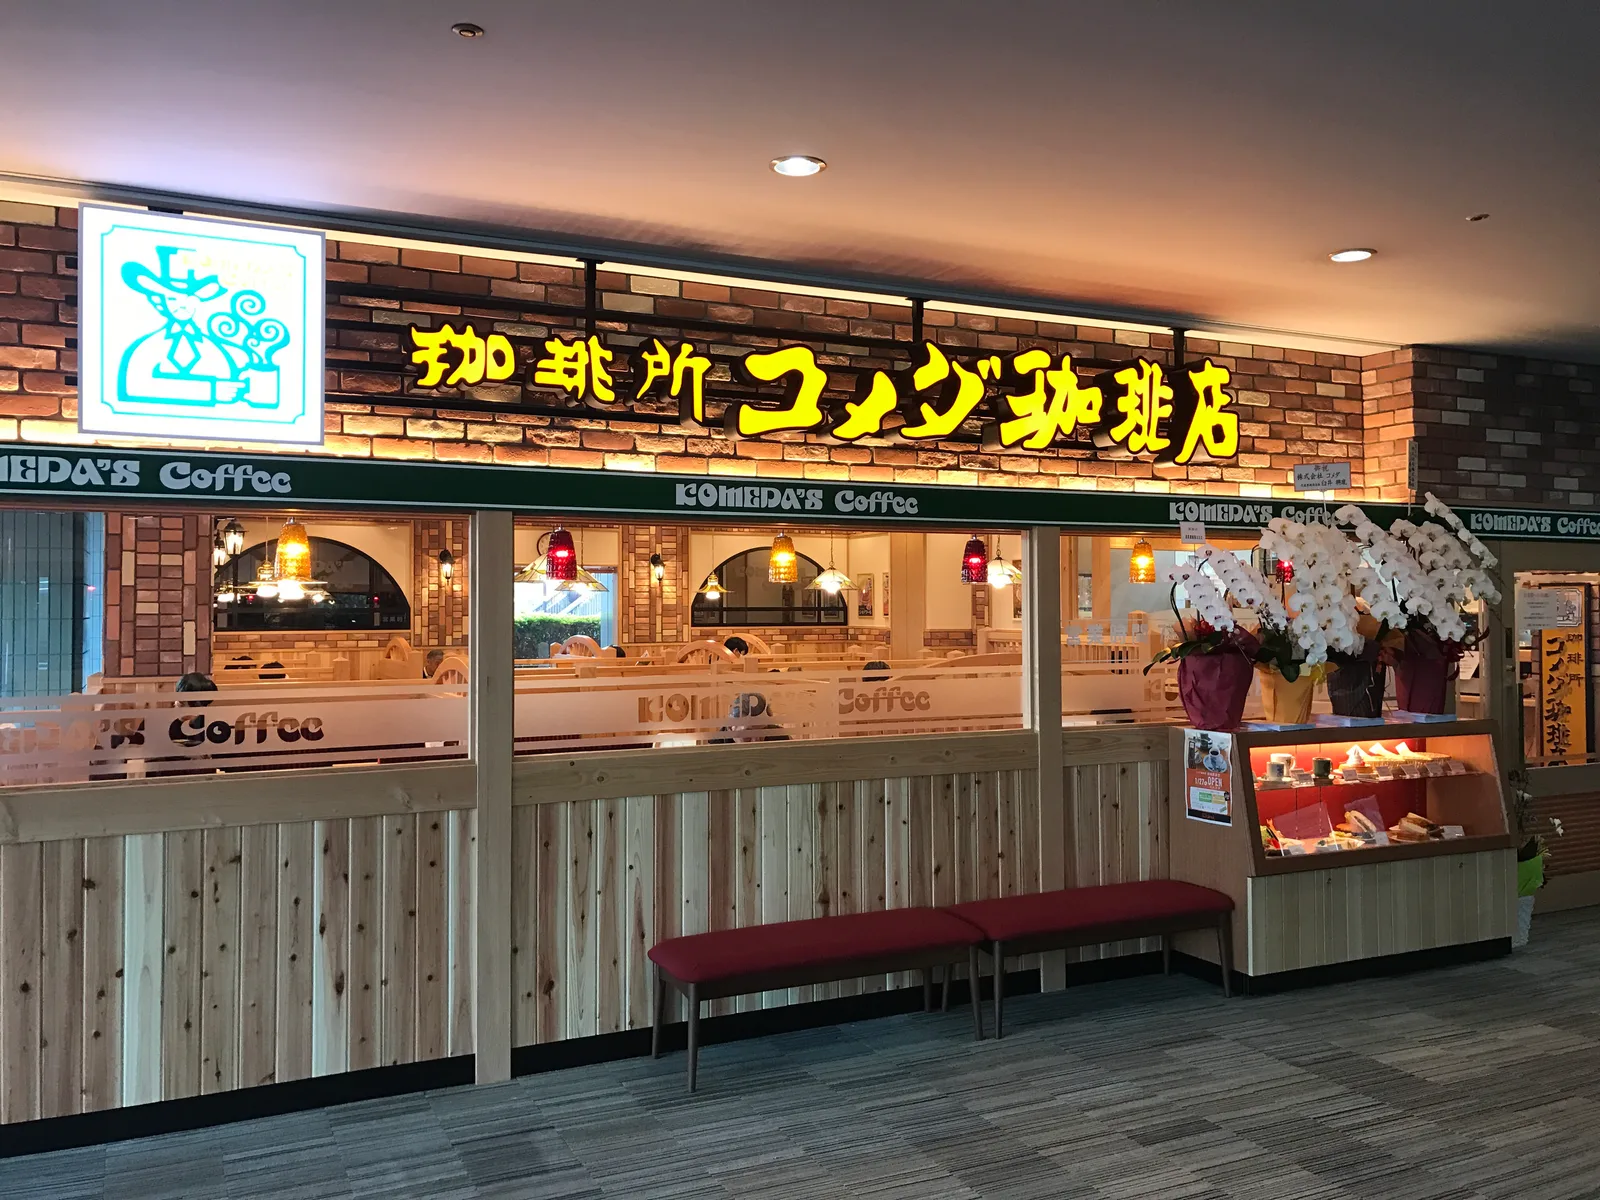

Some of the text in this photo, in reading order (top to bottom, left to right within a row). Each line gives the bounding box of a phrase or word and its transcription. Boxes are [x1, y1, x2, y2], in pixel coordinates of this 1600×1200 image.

[159, 461, 292, 494] Coffee
[675, 482, 919, 514] KOMEDA'S Coffee
[1169, 501, 1273, 523] KOMEDA'S
[1470, 513, 1551, 532] KOMEDA'S
[838, 687, 931, 714] Coffee
[168, 711, 325, 748] Coffee
